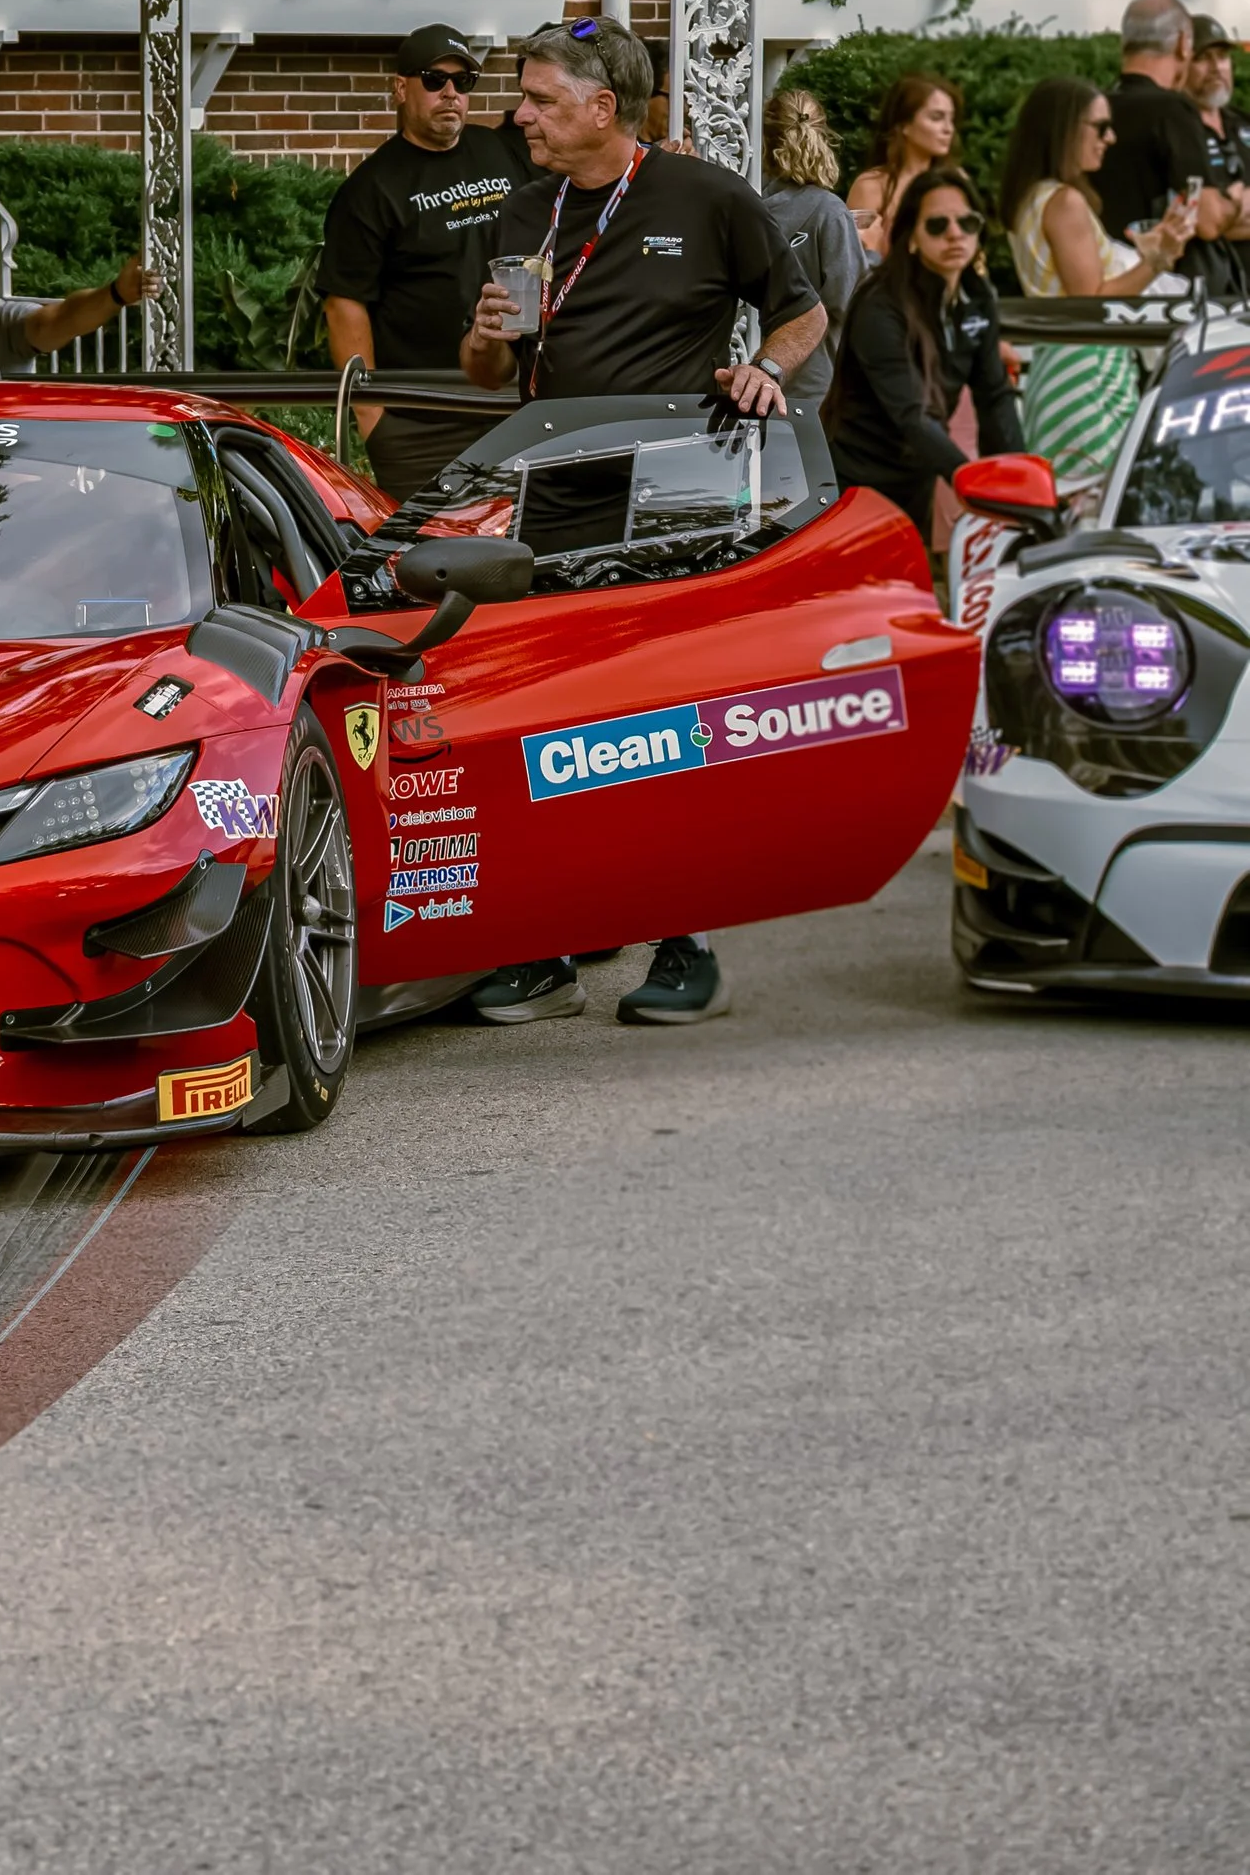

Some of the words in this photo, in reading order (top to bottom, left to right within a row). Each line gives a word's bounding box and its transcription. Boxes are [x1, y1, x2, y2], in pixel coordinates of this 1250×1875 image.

[409, 177, 512, 212] Throttlestop
[387, 683, 446, 699] AMERICA
[539, 727, 681, 785] Clean
[723, 687, 893, 748] Source
[398, 806, 474, 827] cielovision
[403, 833, 477, 865] OPTIMA
[386, 885, 442, 898] PERFORMANCE
[440, 880, 479, 892] COOLANTS
[389, 870, 416, 890] TAY
[418, 863, 480, 887] FROSTY
[417, 894, 474, 921] vbrick
[171, 1061, 248, 1116] PIRELLI
